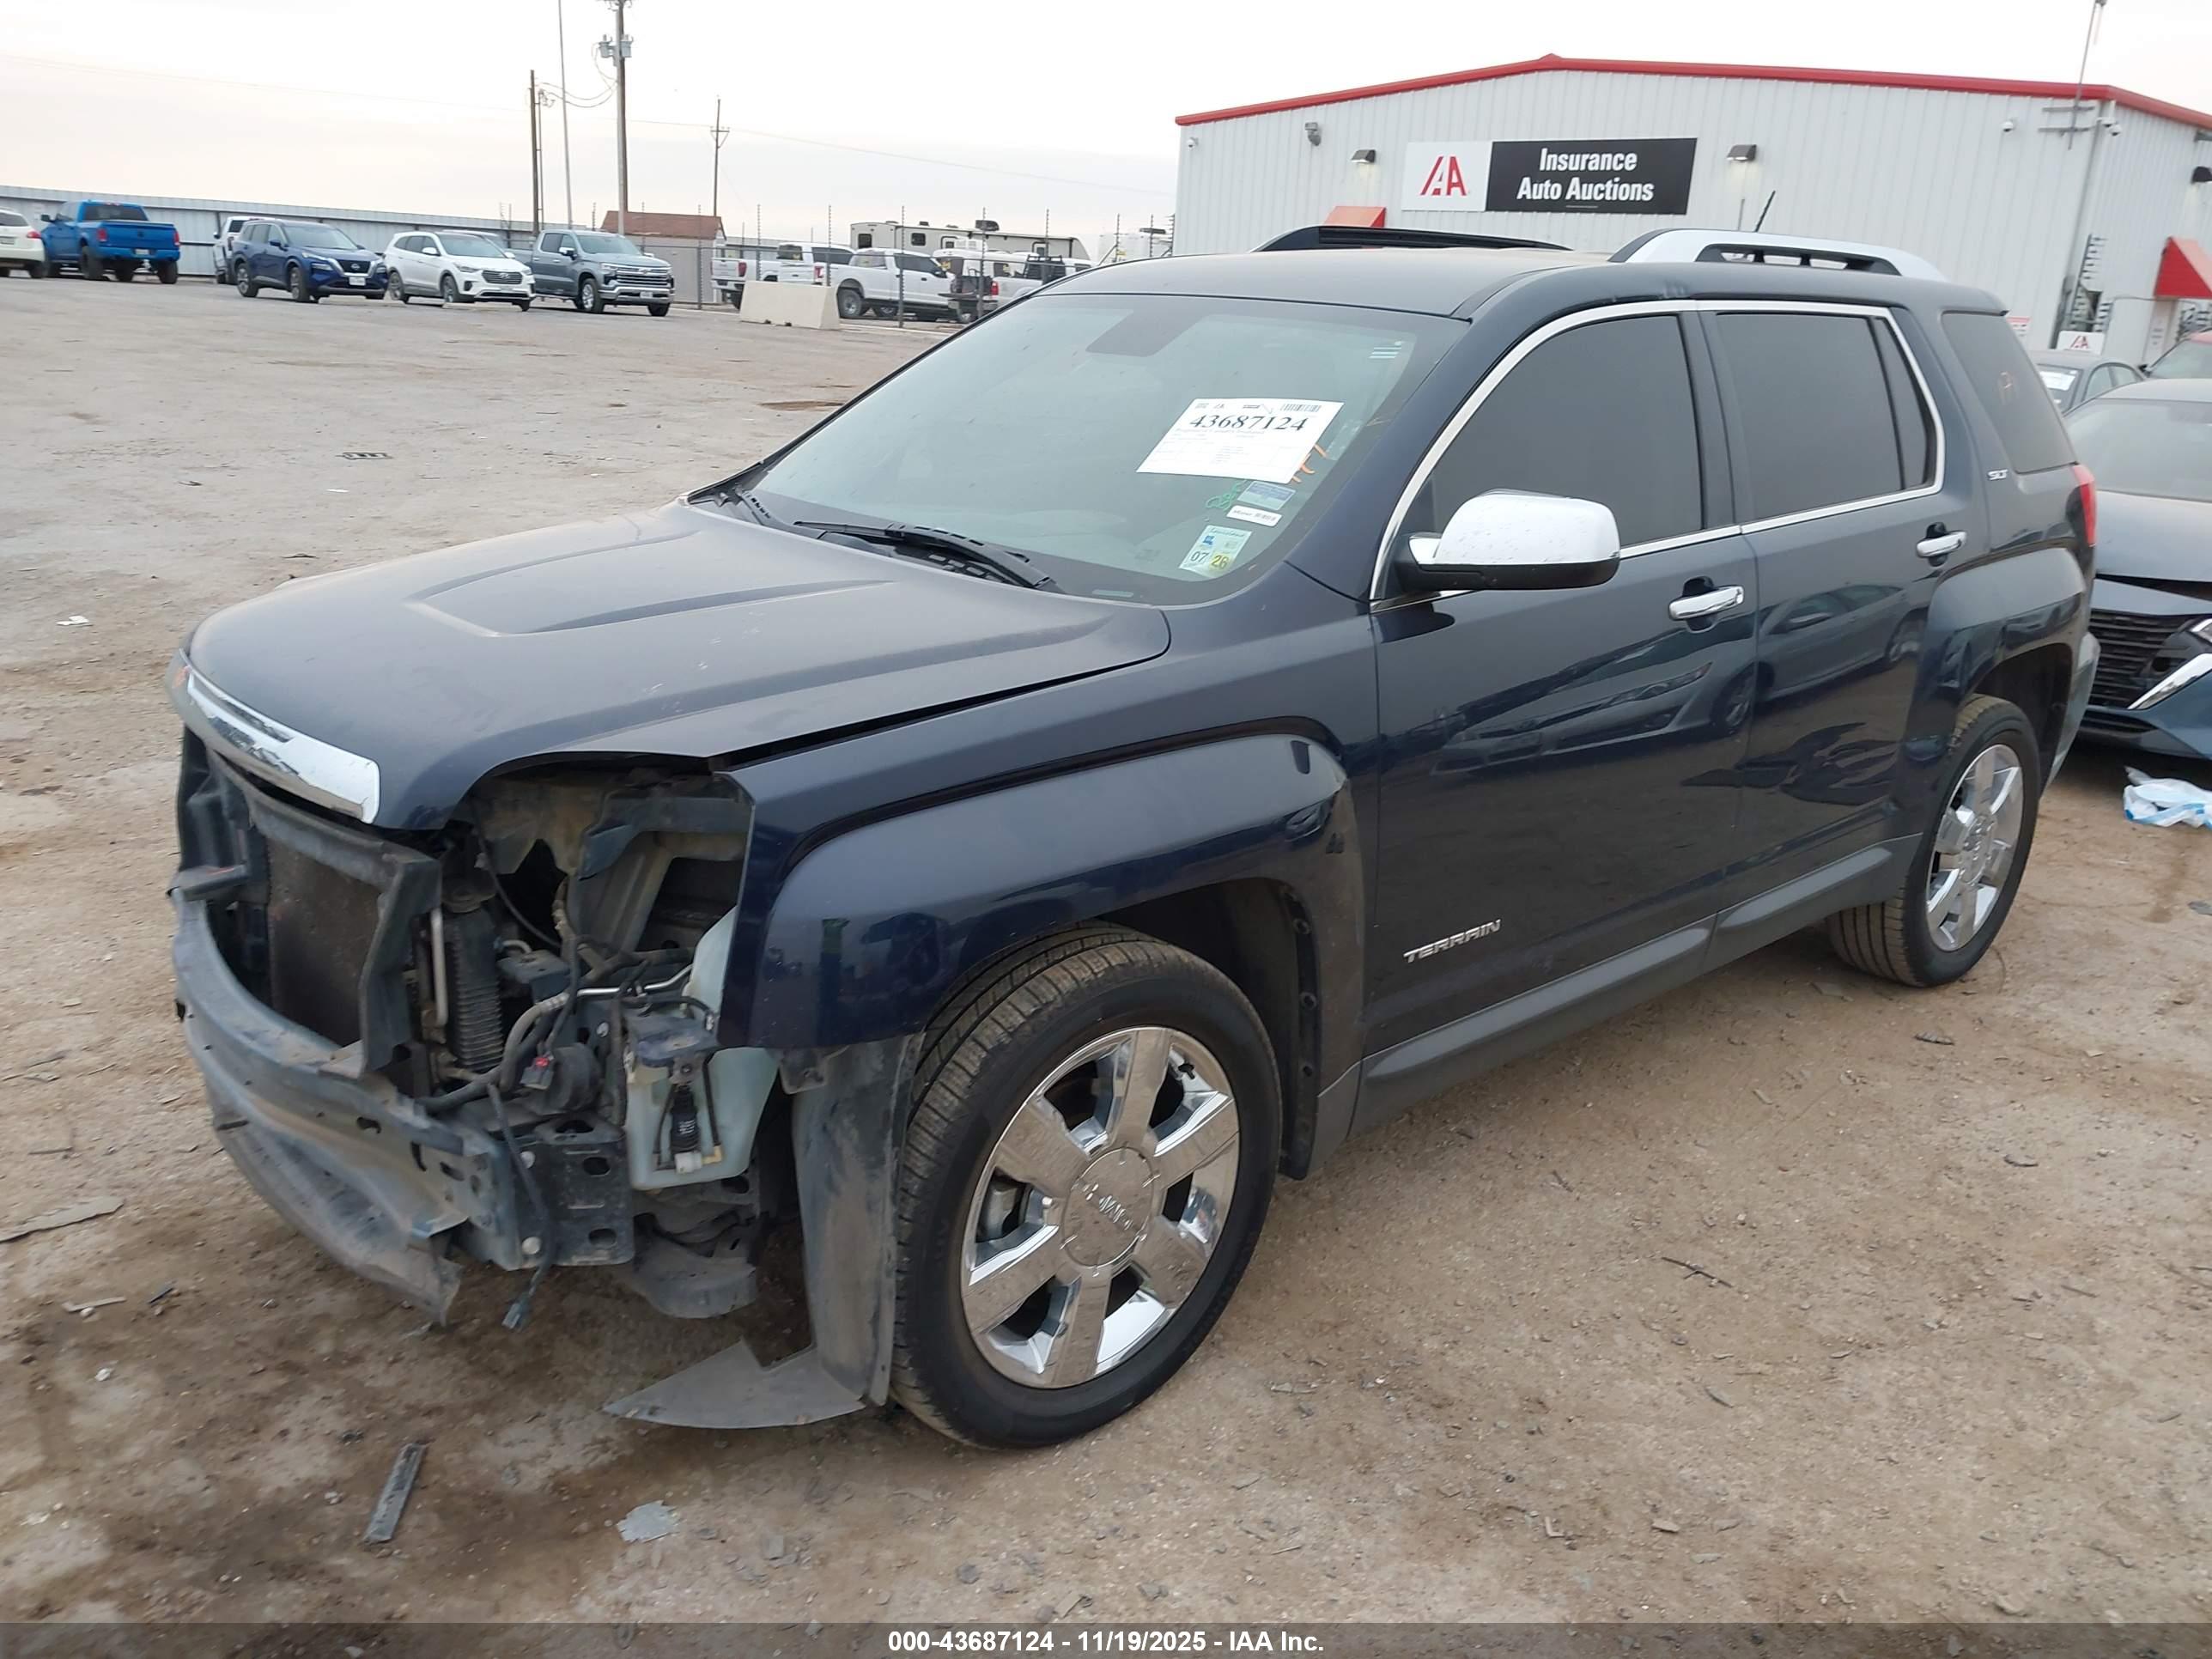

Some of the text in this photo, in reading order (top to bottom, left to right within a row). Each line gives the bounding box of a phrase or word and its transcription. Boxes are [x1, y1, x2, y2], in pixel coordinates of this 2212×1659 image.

[1539, 147, 1638, 172] Insurance
[1516, 177, 1655, 202] Auto Auctions
[1189, 413, 1310, 431] 43687124
[1190, 550, 1230, 569] 07 26
[1402, 918, 1502, 963] TERRAIN
